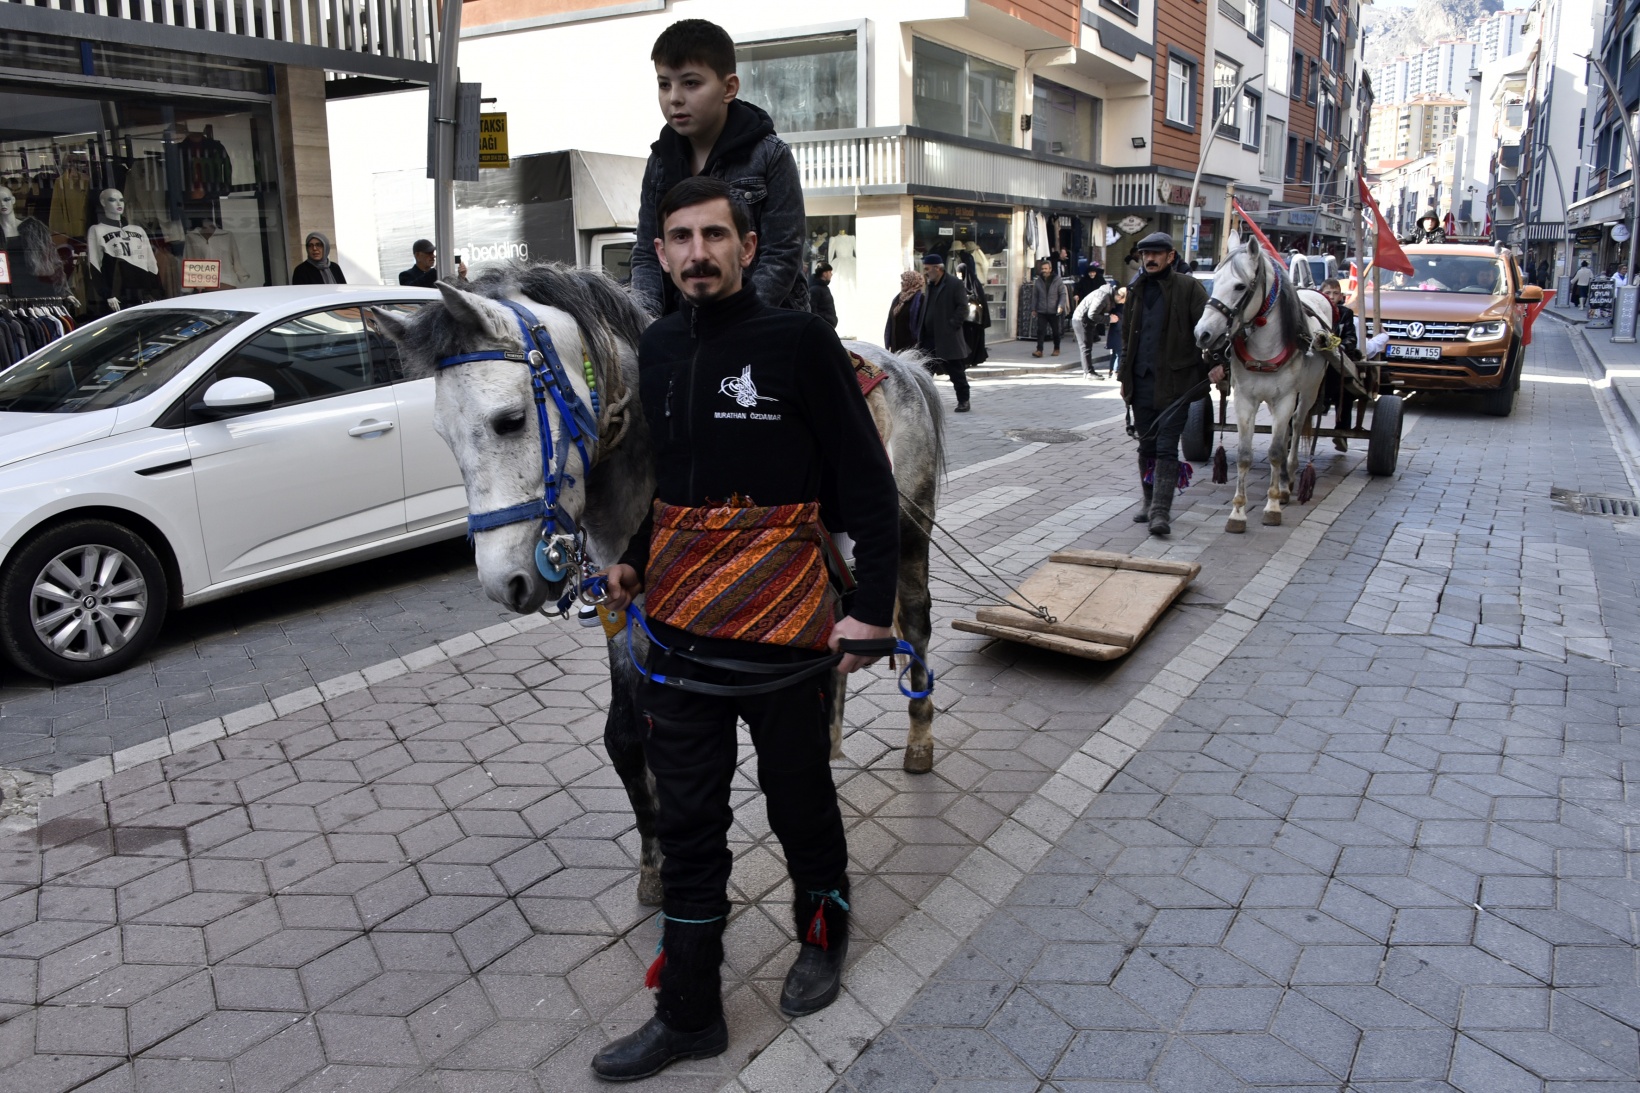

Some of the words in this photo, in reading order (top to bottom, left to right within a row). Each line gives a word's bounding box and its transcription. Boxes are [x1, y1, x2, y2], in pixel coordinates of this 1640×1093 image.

[103, 231, 121, 243] NEW
[120, 242, 131, 256] N
[189, 264, 216, 272] POLAR
[188, 273, 218, 284] 159.99
[1391, 346, 1401, 355] 26
[1405, 347, 1420, 356] AFN
[1425, 348, 1439, 357] 155
[749, 412, 782, 420] ÖZDAMAR
